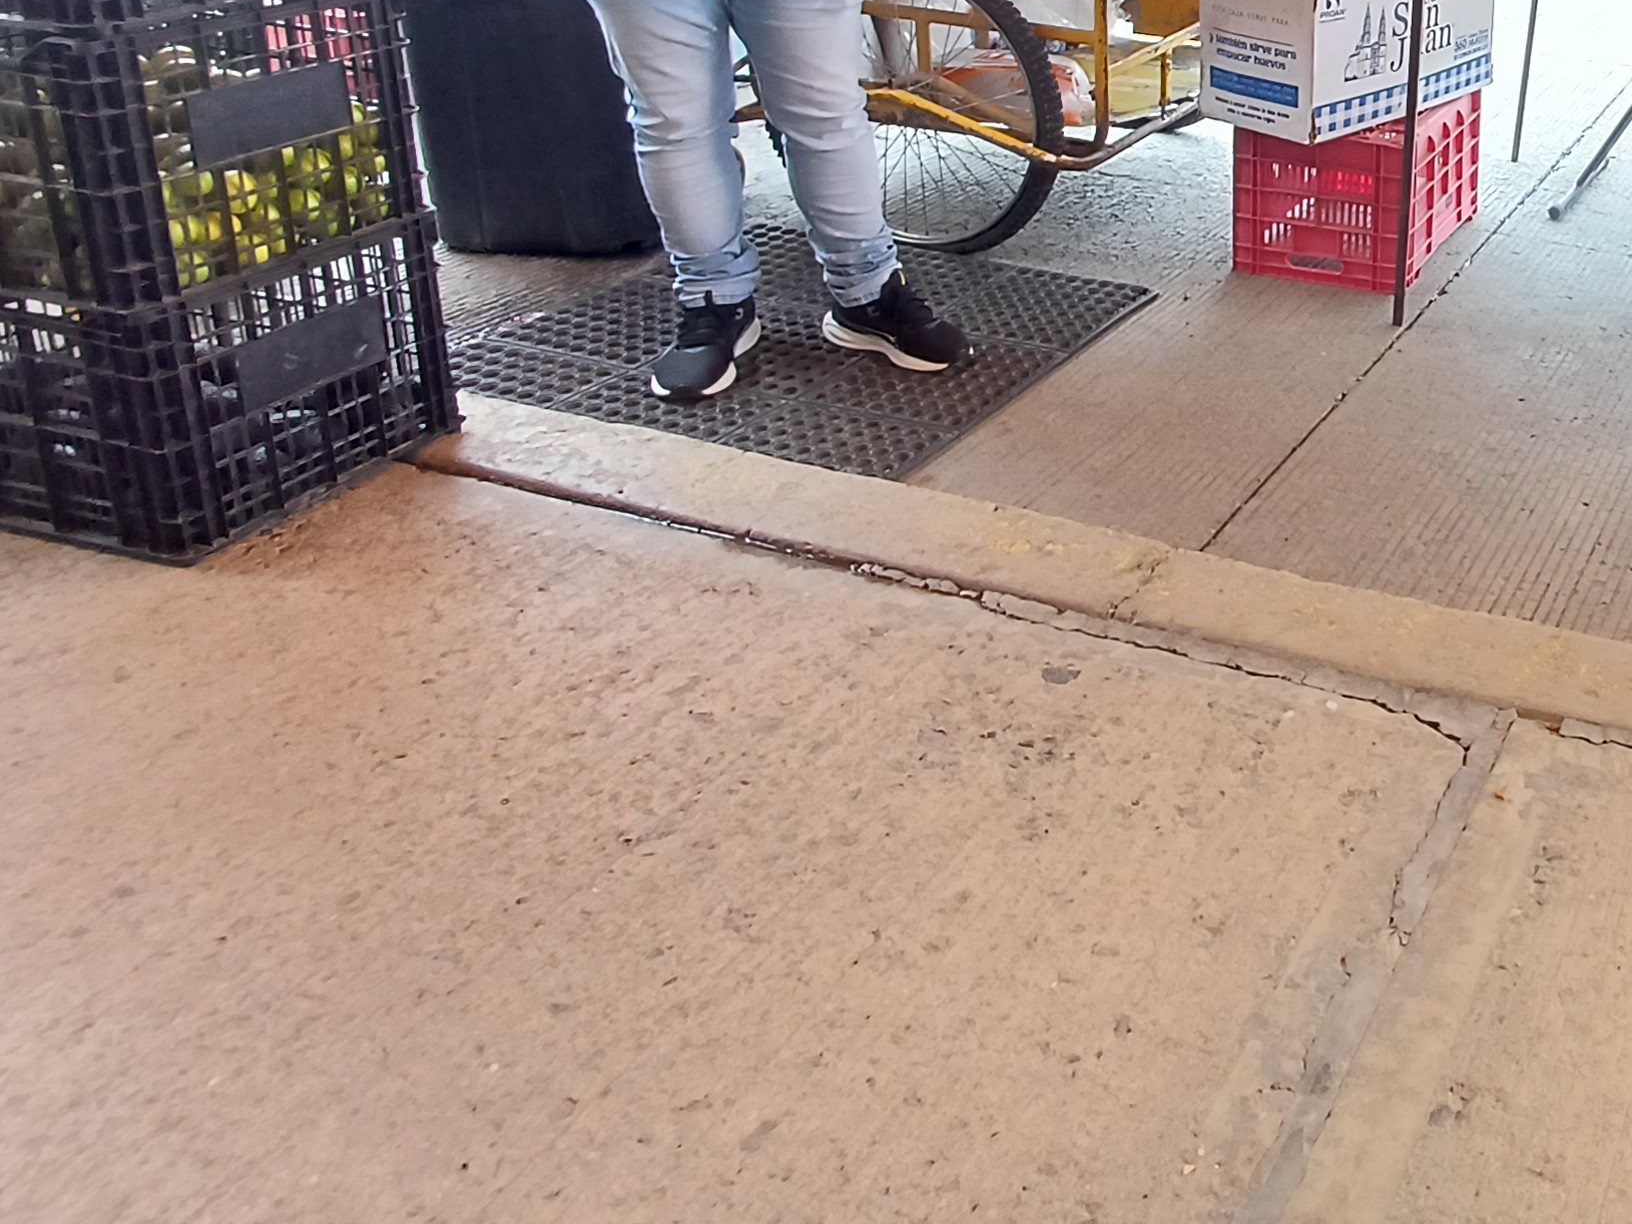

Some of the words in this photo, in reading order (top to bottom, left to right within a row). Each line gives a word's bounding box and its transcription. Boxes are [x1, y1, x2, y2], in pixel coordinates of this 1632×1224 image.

[1392, 2, 1439, 37] Sn
[1250, 43, 1272, 55] sirve
[1275, 47, 1296, 60] para
[1390, 23, 1452, 72] Jan
[1254, 56, 1286, 70] huevos
